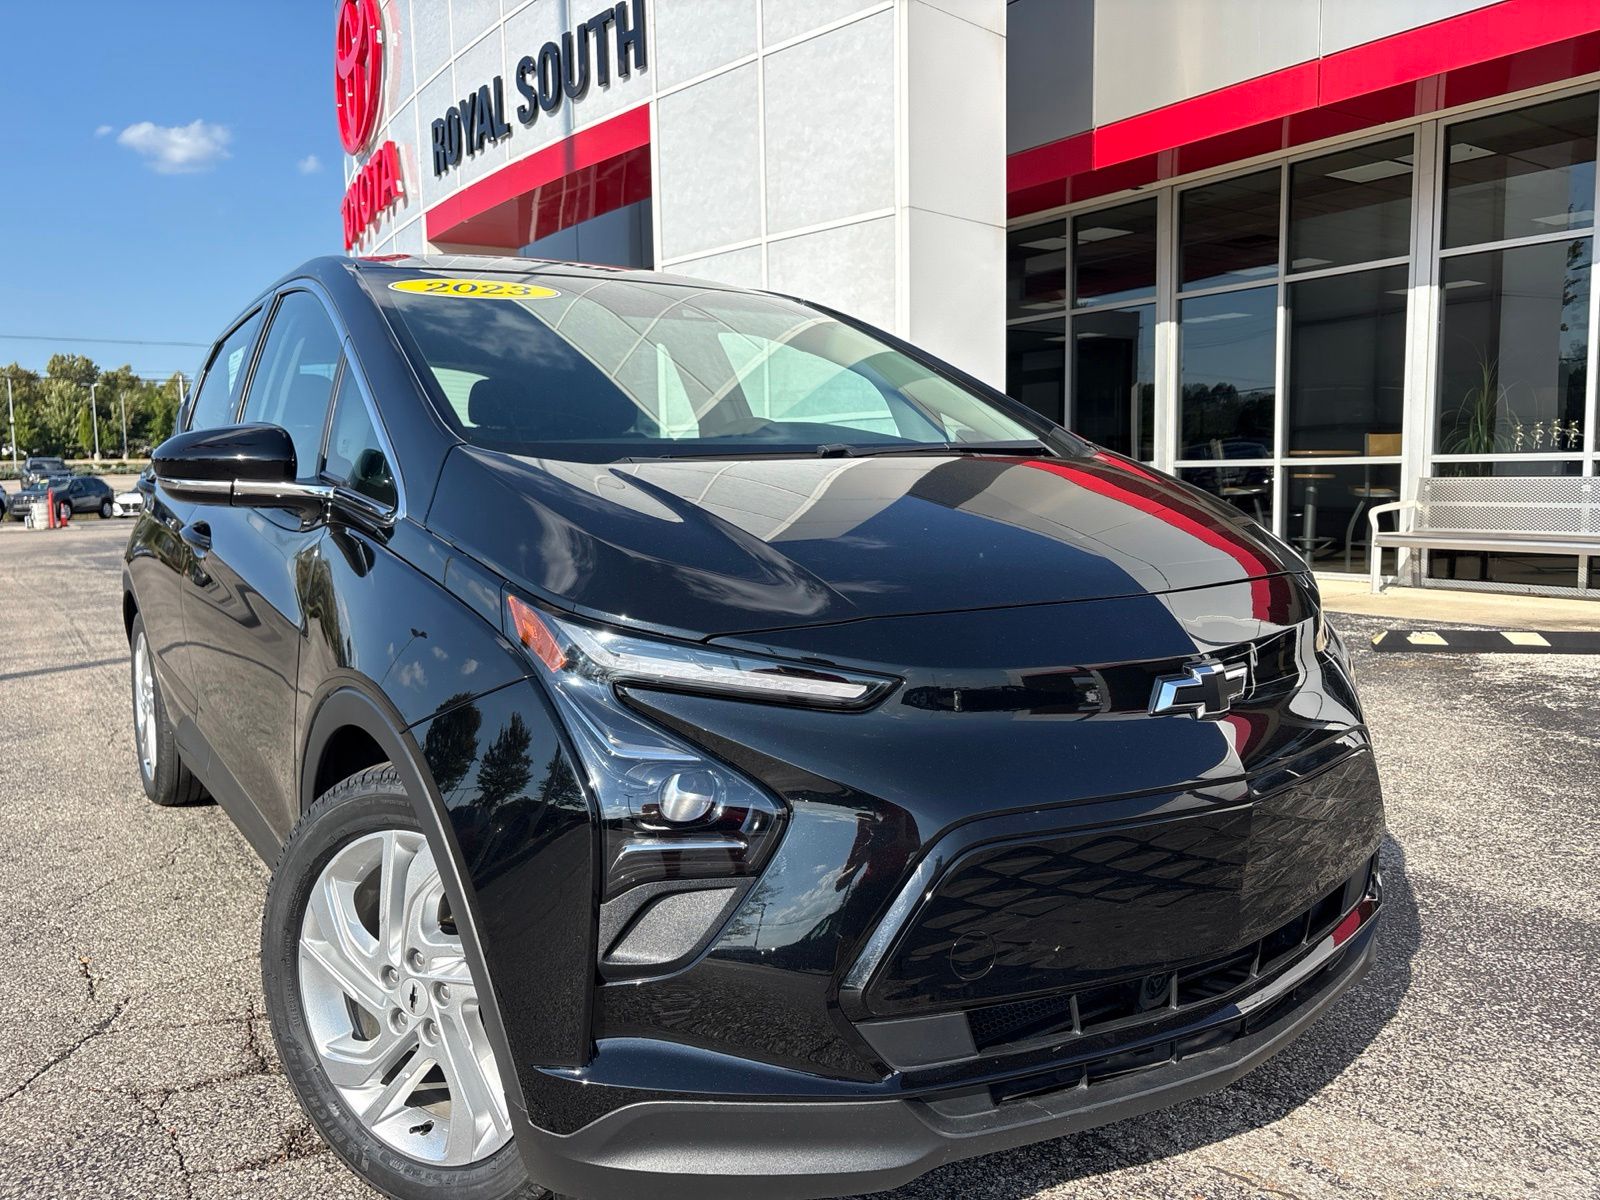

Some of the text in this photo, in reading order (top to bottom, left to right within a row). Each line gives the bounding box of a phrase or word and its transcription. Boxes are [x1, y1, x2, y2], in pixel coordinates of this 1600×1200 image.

[431, 0, 646, 177] ROYAL SOUTH
[424, 282, 531, 296] 2023
